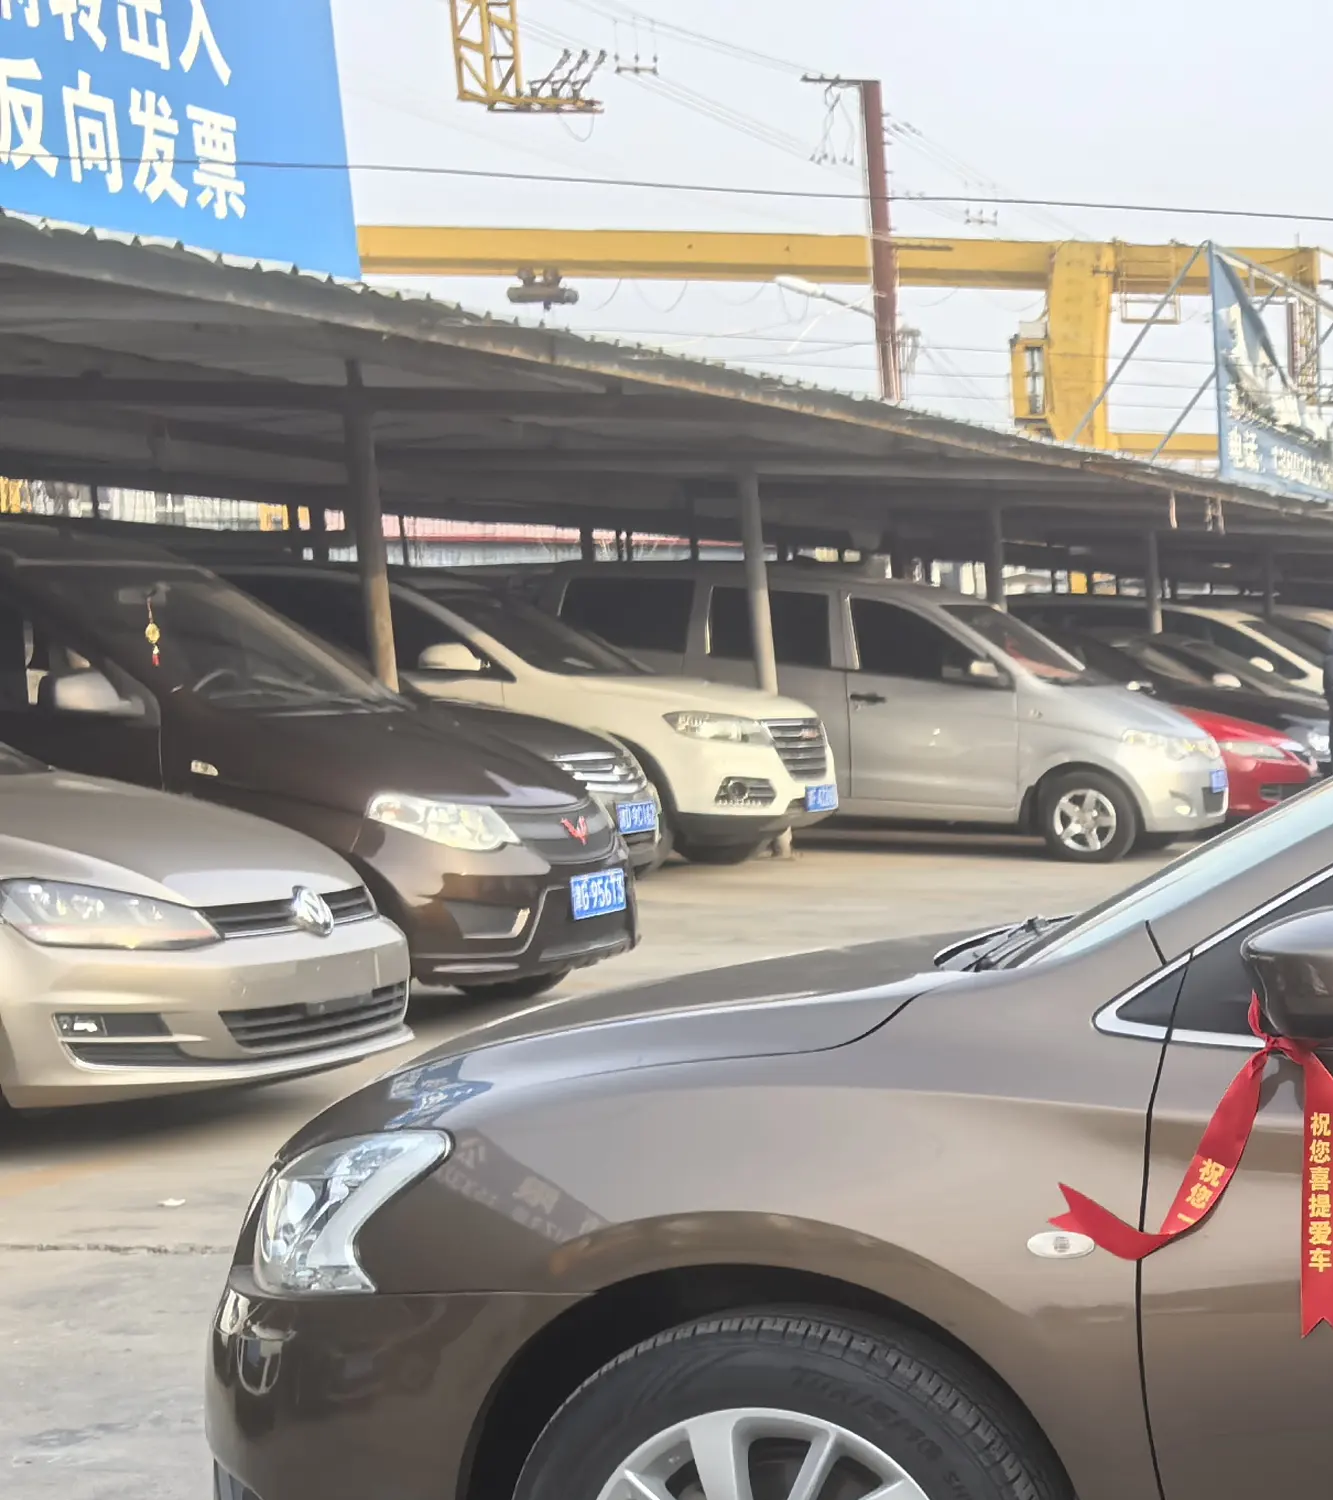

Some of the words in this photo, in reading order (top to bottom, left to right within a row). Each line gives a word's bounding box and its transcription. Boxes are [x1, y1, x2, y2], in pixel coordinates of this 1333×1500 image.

[0, 57, 247, 219] 反向发票
[1308, 1111, 1332, 1273] 祝您喜提爱车
